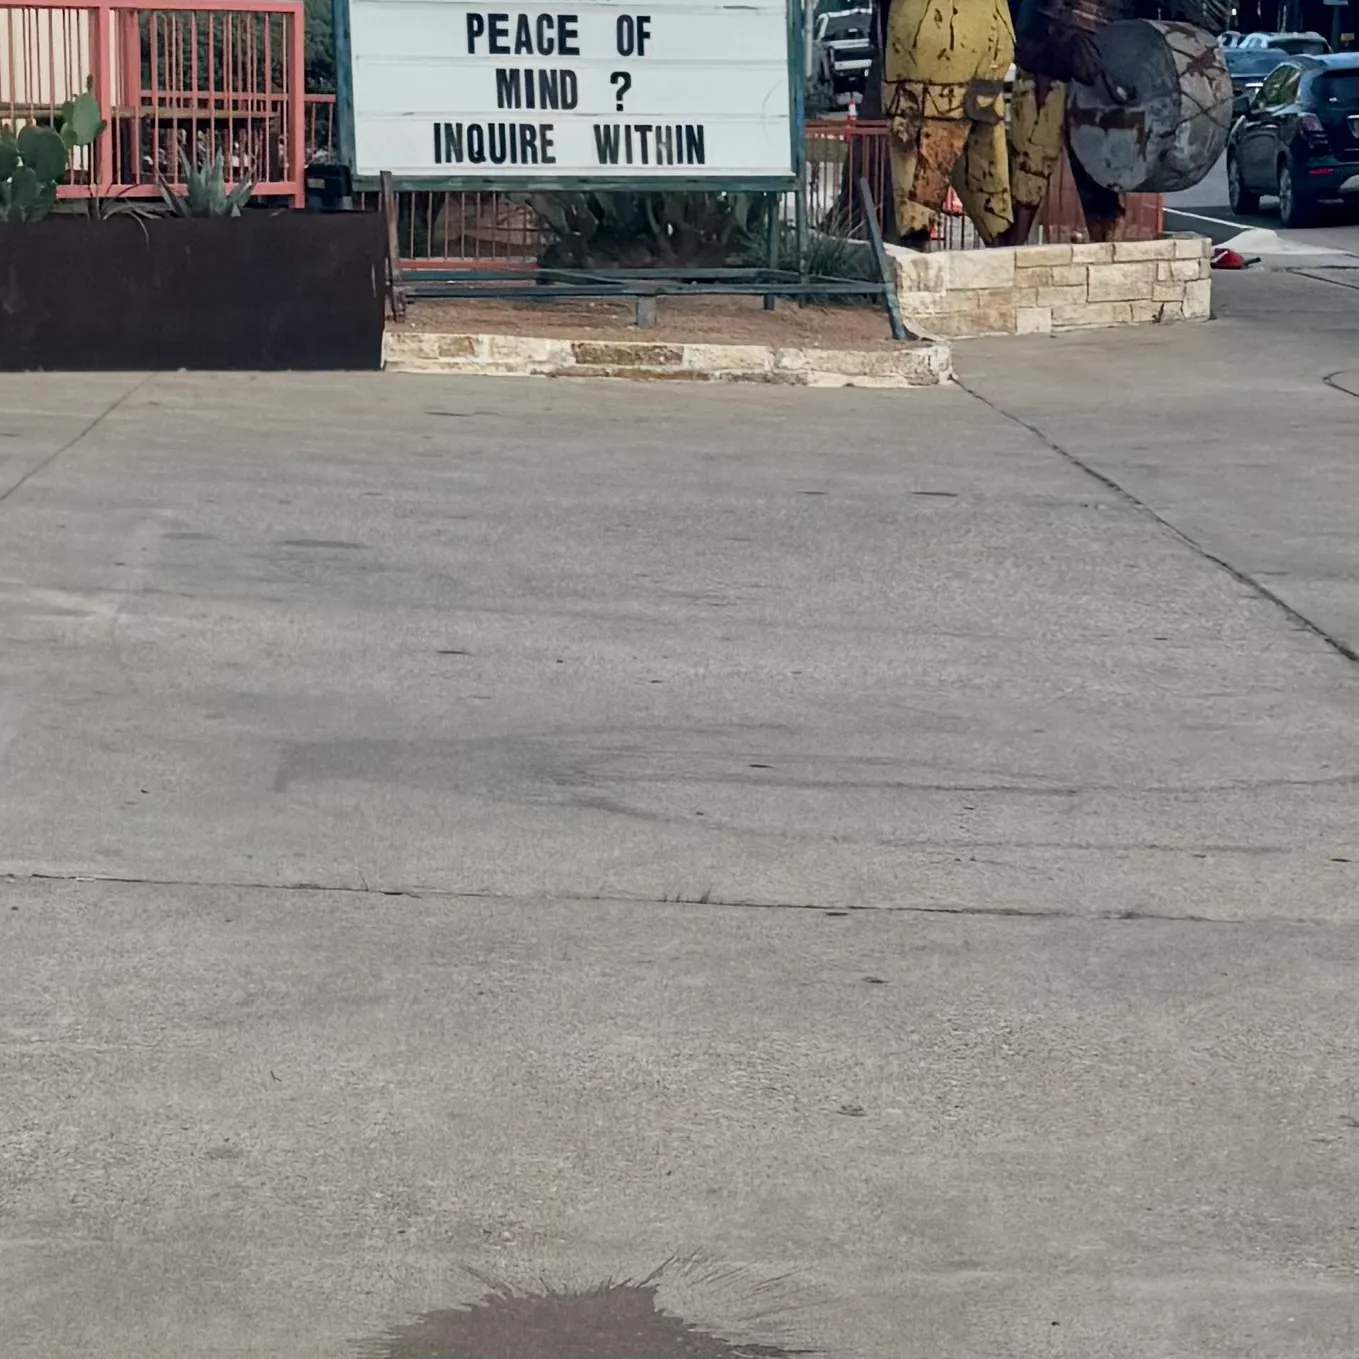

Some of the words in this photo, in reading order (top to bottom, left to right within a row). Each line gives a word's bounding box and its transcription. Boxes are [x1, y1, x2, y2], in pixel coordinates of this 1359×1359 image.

[467, 13, 580, 56] PEACE
[616, 14, 652, 57] OF
[496, 68, 578, 110] MIND
[609, 71, 632, 112] ?
[434, 123, 557, 165] INQUIRE
[594, 124, 706, 166] WITHIN
